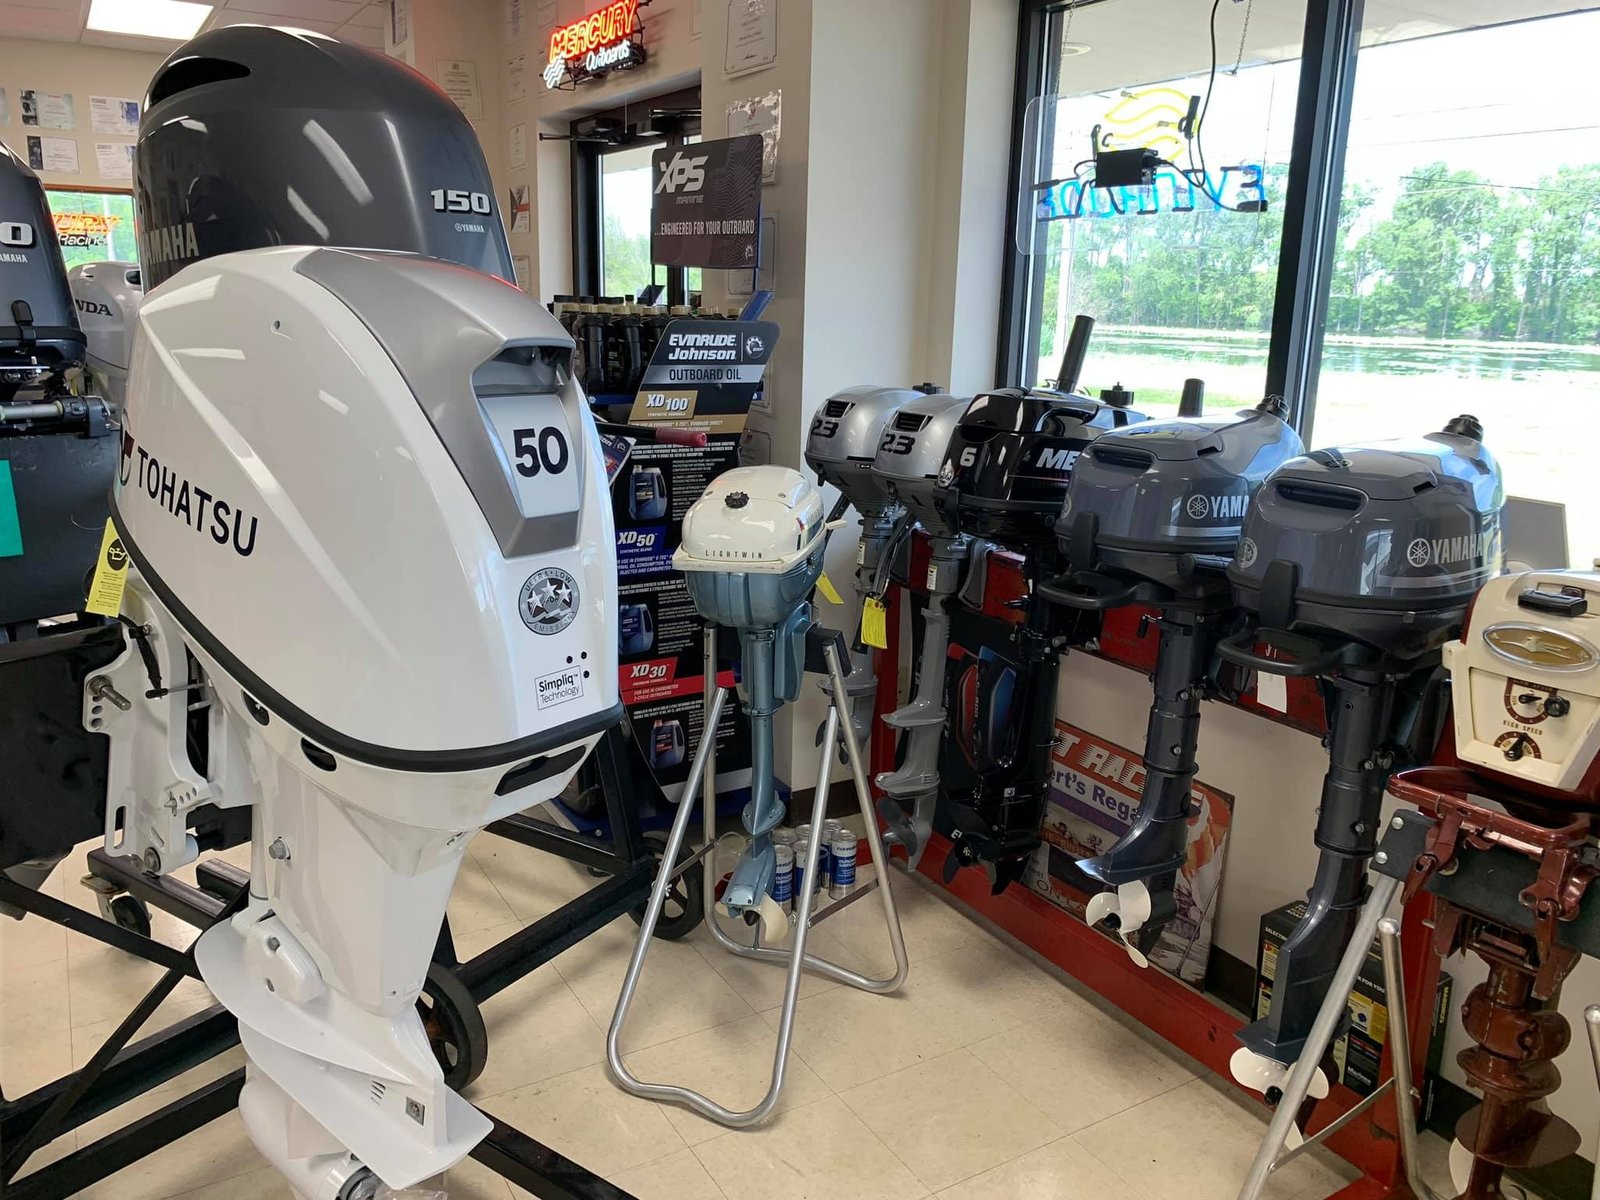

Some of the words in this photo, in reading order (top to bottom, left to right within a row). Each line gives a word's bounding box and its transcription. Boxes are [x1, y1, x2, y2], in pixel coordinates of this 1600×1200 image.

[549, 0, 638, 64] MERCURY
[586, 39, 630, 71] Outboards
[654, 152, 709, 194] XPS
[431, 189, 490, 214] 150
[462, 224, 485, 233] YAMAHA
[694, 222, 705, 235] FOR
[706, 221, 721, 235] YOUR
[722, 220, 755, 234] OUTBOARD
[668, 334, 737, 347] EVINRUDE
[668, 347, 736, 361] Johnson
[669, 369, 724, 381] OUTBOARD
[726, 368, 742, 380] OIL
[513, 426, 569, 478] 50
[960, 447, 978, 467] 6
[137, 445, 258, 557] TOHATSU
[705, 550, 763, 559] LIGHTWIN
[1432, 532, 1483, 565] YAMAHA
[555, 569, 572, 584] LOW
[540, 686, 580, 704] Technology
[1502, 720, 1519, 729] HIGH
[1522, 726, 1543, 736] SPEED
[1051, 769, 1086, 796] rt's
